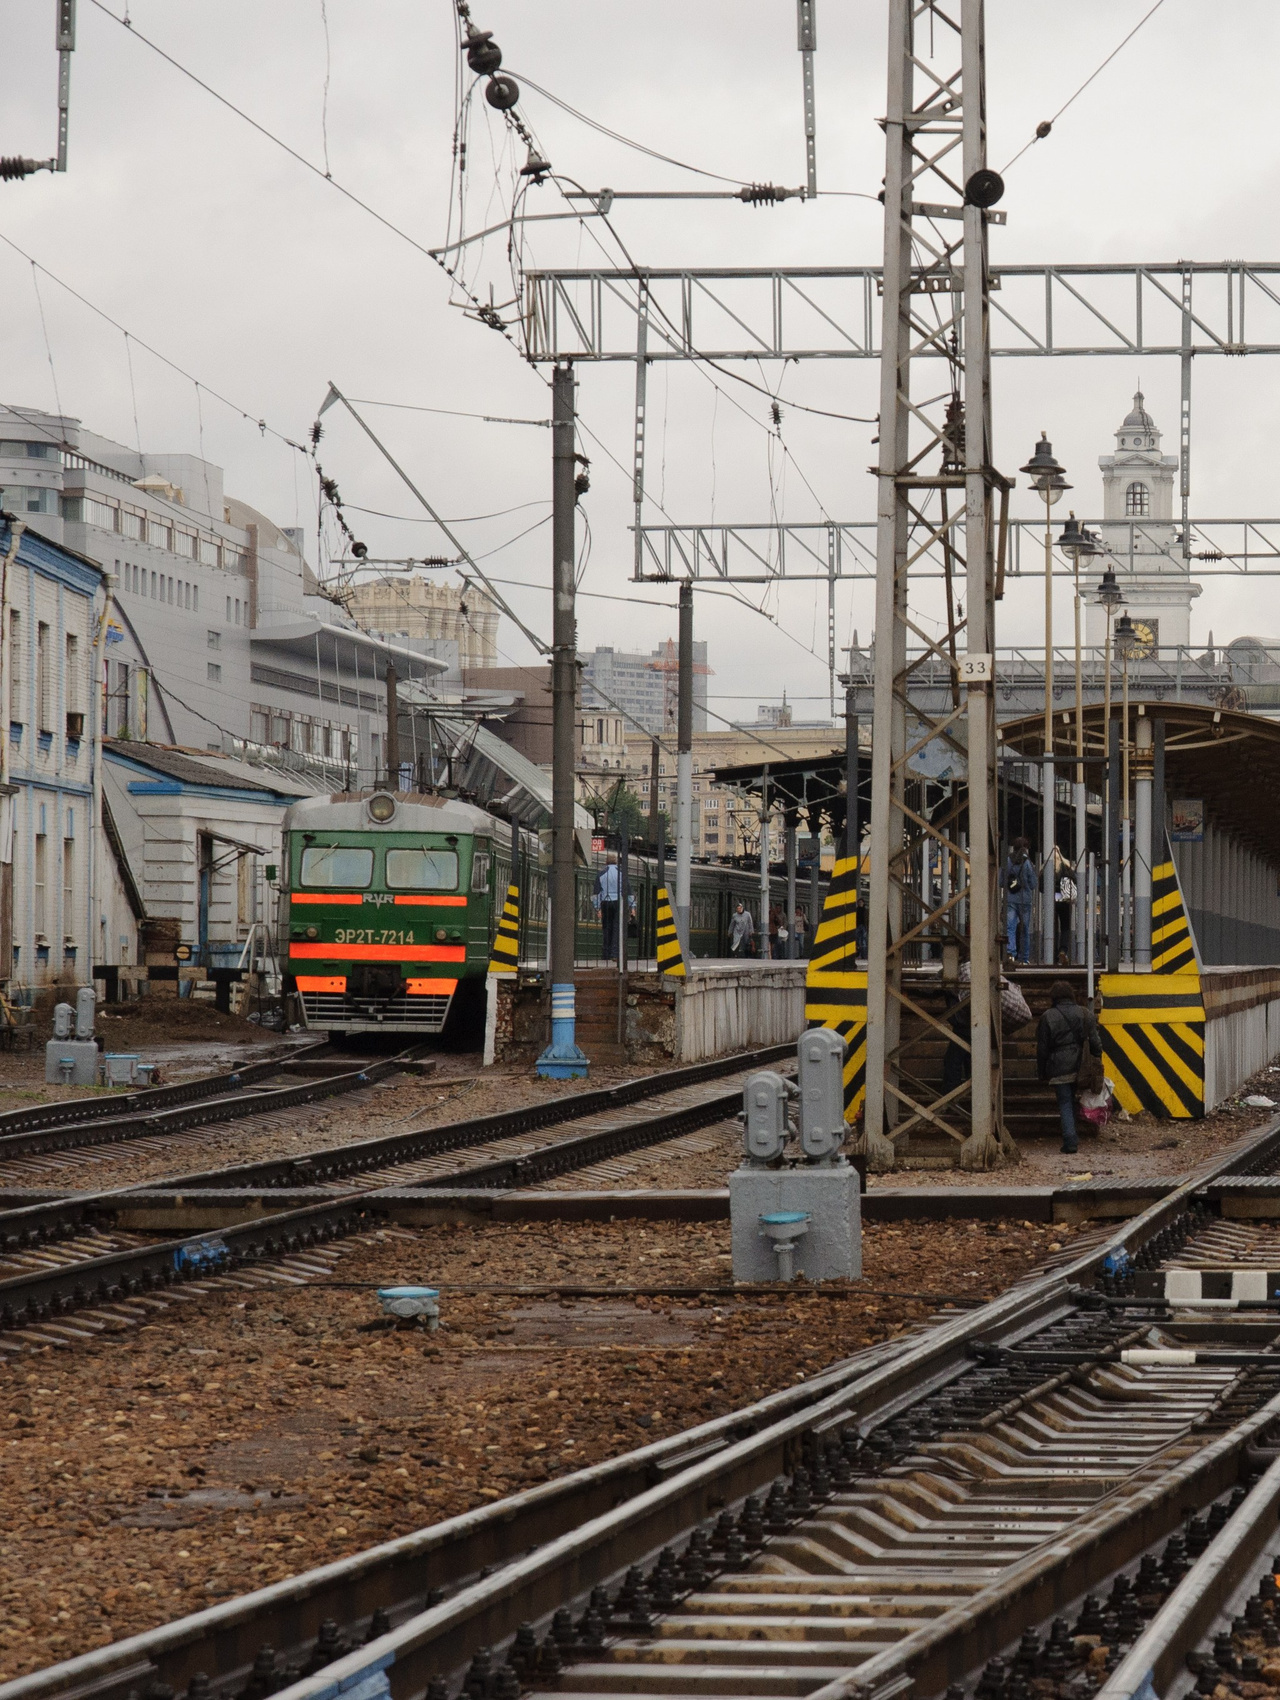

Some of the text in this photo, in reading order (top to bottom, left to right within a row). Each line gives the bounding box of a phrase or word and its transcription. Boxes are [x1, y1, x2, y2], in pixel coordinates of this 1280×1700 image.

[965, 661, 986, 674] 33
[362, 892, 394, 909] RVR
[335, 928, 415, 945] ЭР2Т-7214
